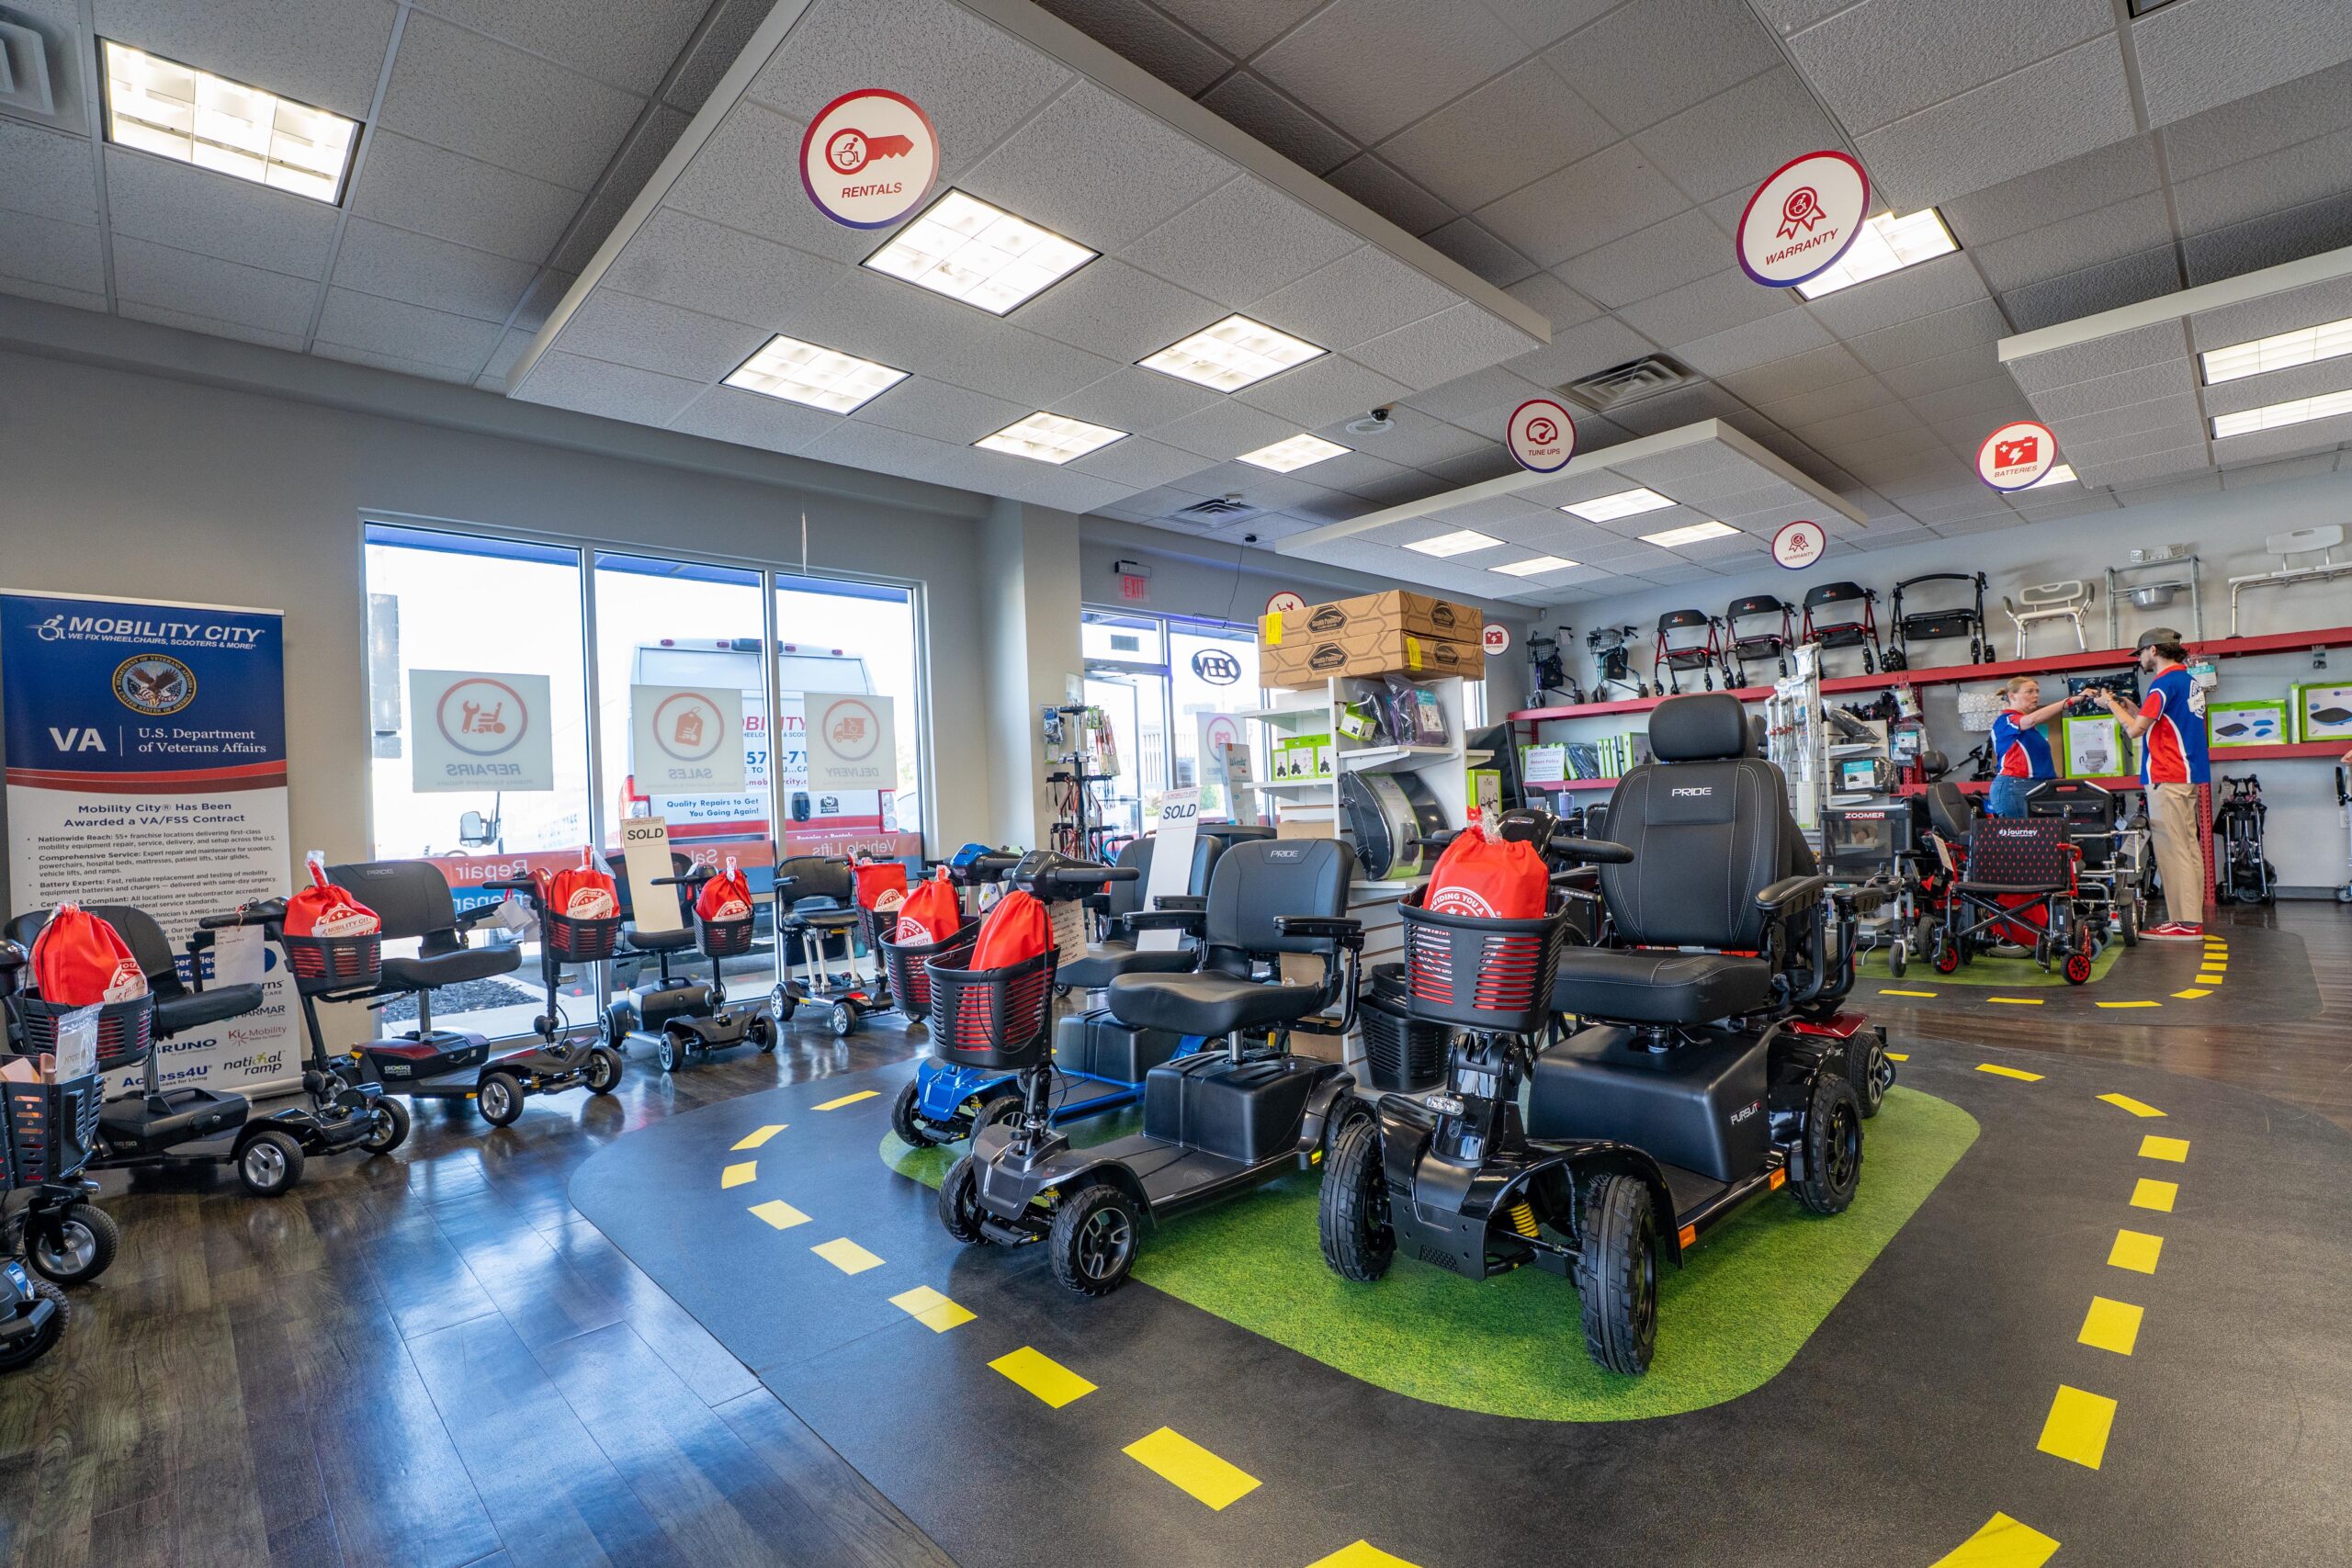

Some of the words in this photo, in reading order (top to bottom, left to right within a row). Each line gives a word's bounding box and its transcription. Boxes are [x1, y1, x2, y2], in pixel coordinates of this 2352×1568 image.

[842, 183, 902, 198] RENTALS
[1766, 228, 1838, 265] WARRANTY
[1995, 465, 2038, 478] BATTERIES
[1124, 575, 1144, 599] EXIT
[69, 616, 201, 637] MOBILITY
[205, 626, 261, 643] CITY
[101, 635, 168, 646] WHEELCHAIRS,
[171, 638, 218, 648] SCOOTERS
[226, 641, 257, 650] MORE!
[50, 728, 107, 752] VA
[138, 728, 168, 739] U.S.
[173, 728, 255, 741] Department
[138, 742, 149, 752] of
[152, 742, 219, 753] Veterans
[221, 741, 266, 753] Affairs
[1671, 787, 1713, 796] PRIDE
[78, 805, 131, 814] Mobility
[1163, 804, 1196, 819] SOLD
[64, 818, 124, 827] Awarded
[140, 816, 188, 825] VA/FSS
[193, 815, 245, 823] Contract
[628, 829, 663, 840] SOLD
[39, 853, 106, 862] Comprehensive
[1271, 850, 1299, 858] PRIDE
[39, 862, 85, 870] powerchairs,
[72, 879, 105, 887] Experts:
[86, 897, 129, 905] Compliant:
[1462, 895, 1478, 908] YOU
[249, 1026, 288, 1036] Mobility
[158, 1039, 217, 1054] RUNO
[244, 1063, 282, 1076] ramp
[122, 1066, 208, 1088] Acess4U
[1731, 1102, 1758, 1125] PURSUIT
